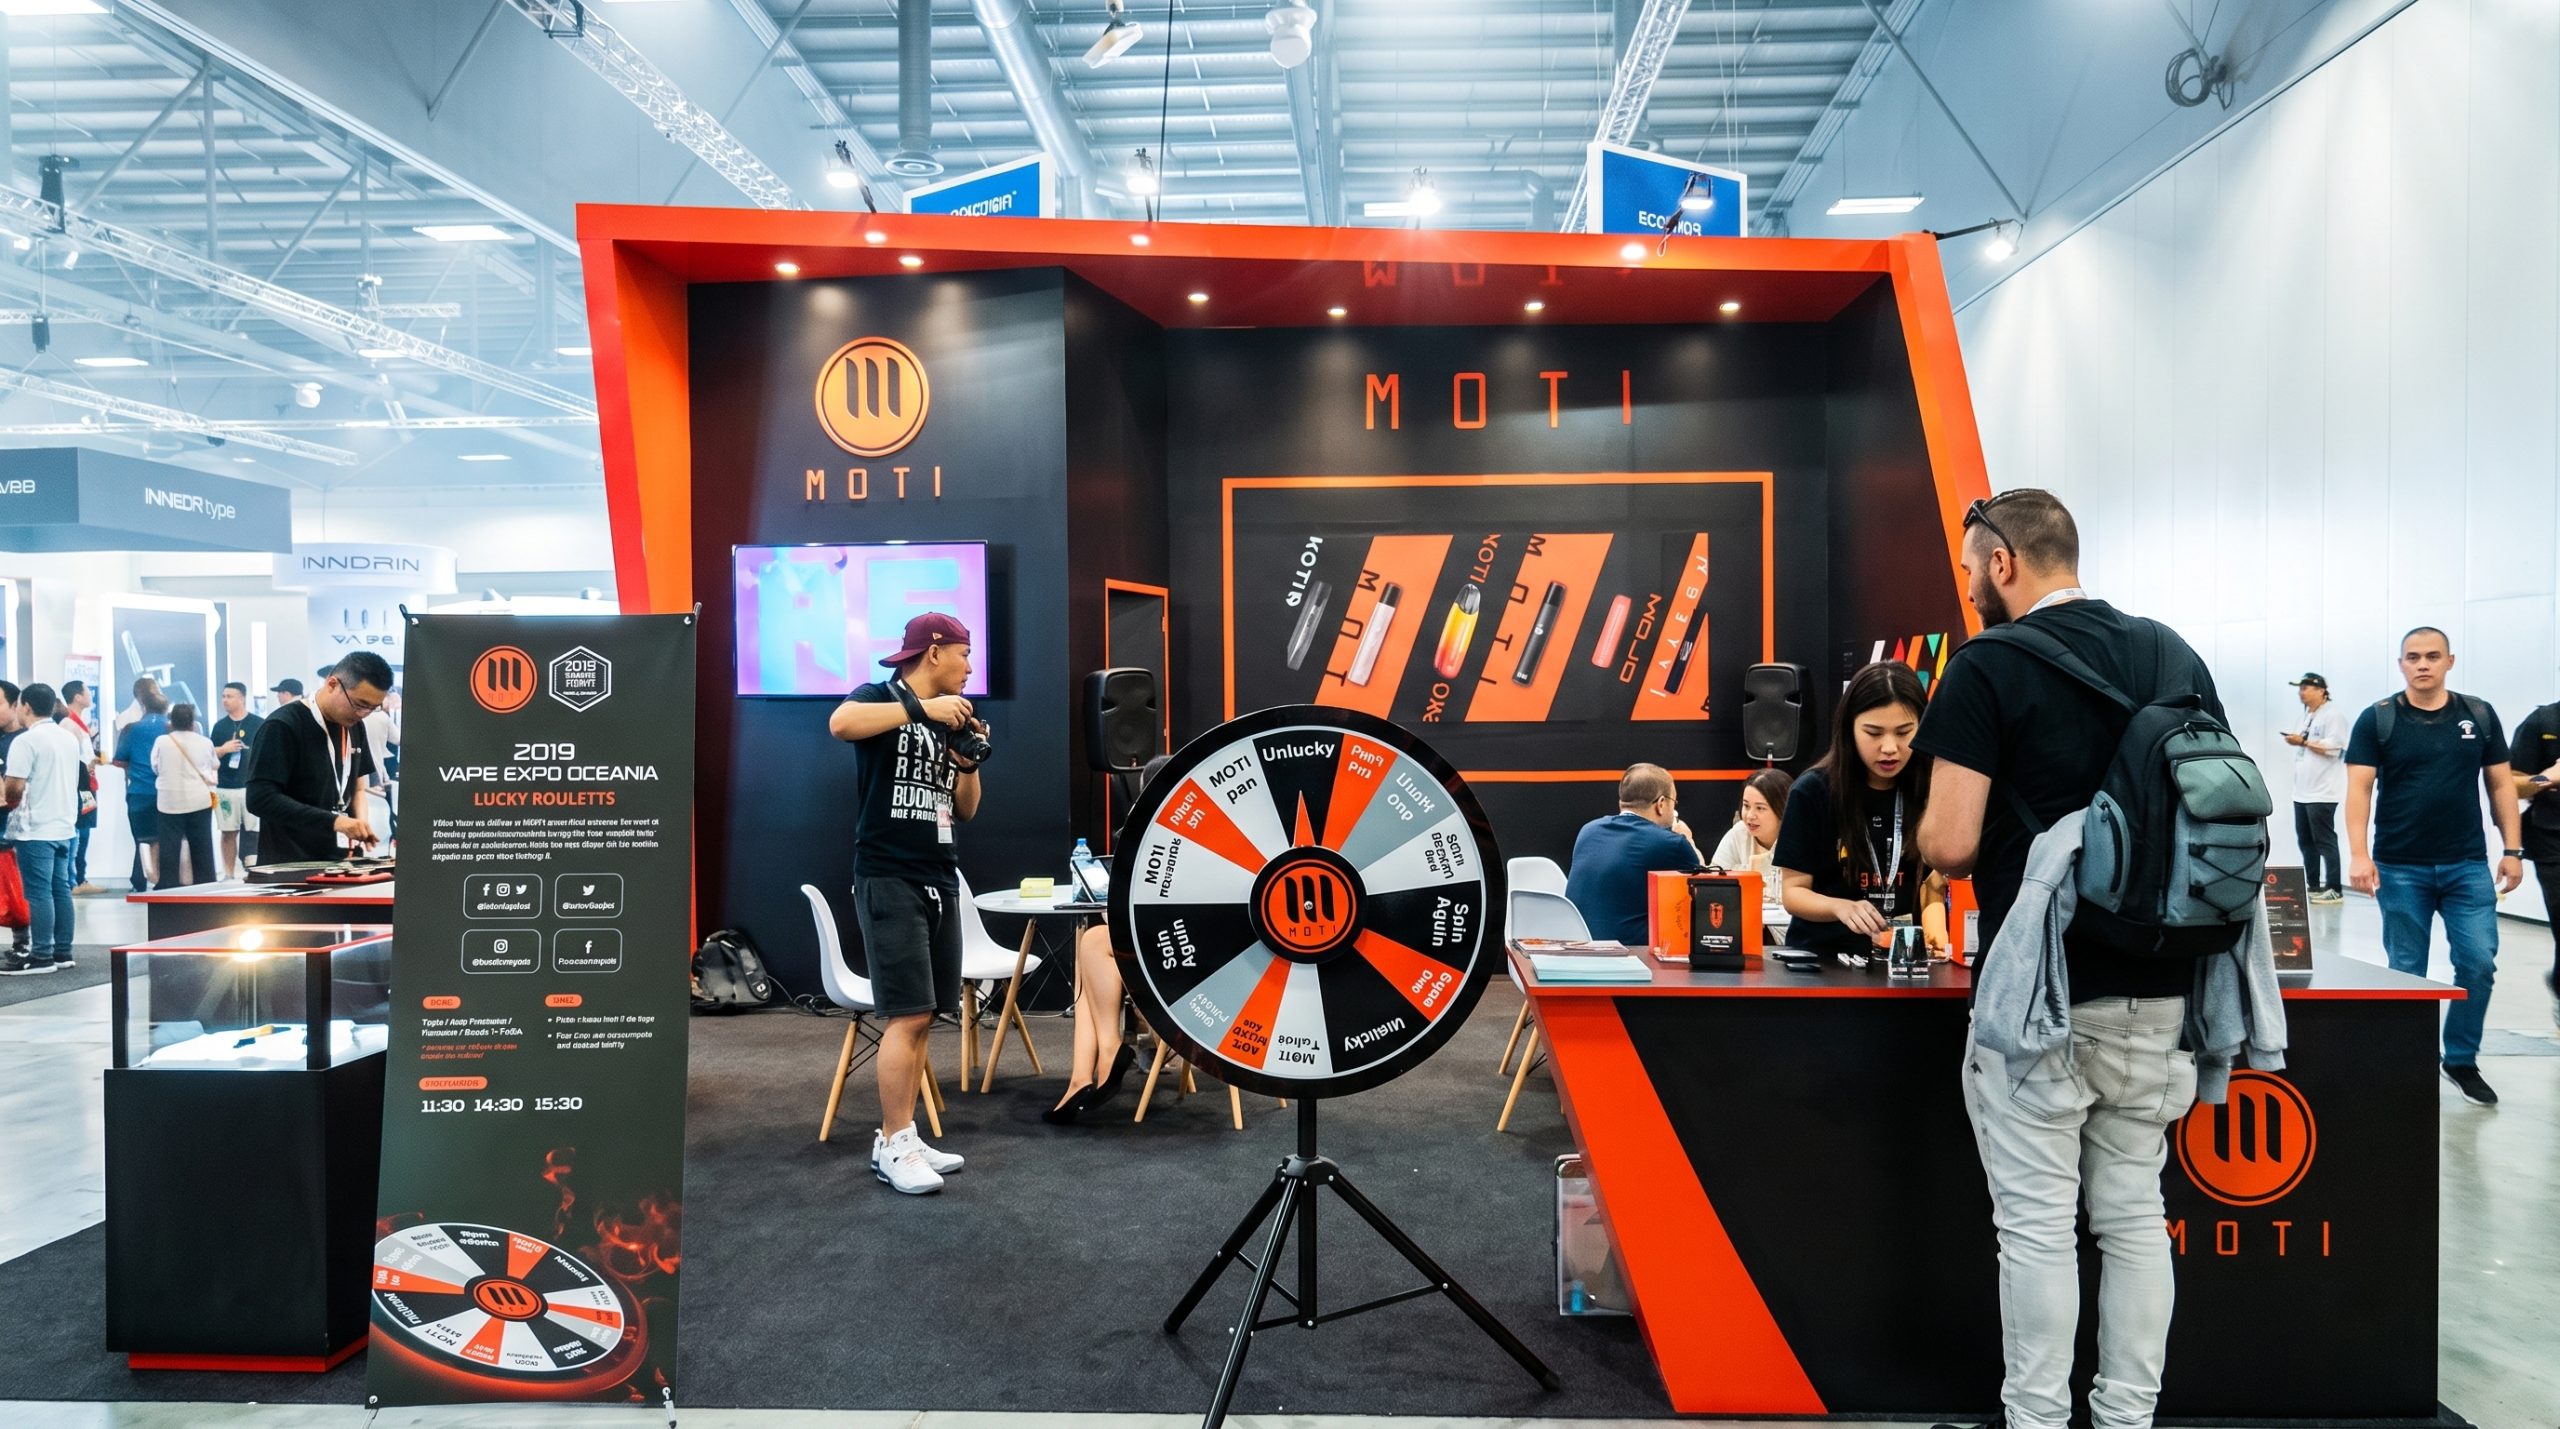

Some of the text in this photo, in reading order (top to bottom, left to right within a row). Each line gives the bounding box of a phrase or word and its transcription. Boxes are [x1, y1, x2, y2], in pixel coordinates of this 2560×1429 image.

[1365, 370, 1632, 430] MOTI
[806, 466, 942, 500] MOTI
[205, 499, 236, 520] type
[303, 556, 420, 571] INNDRIN
[513, 743, 575, 761] 2019
[1262, 741, 1336, 762] Unlucky
[439, 765, 659, 782] VAPE EXPO OCEANIA
[1209, 755, 1252, 788] MOTI
[474, 791, 616, 807] LUCKY ROULETTS
[1226, 777, 1258, 804] pan
[1144, 844, 1166, 884] MOTI
[1289, 926, 1336, 937] MOTI
[1432, 896, 1451, 946] Aguin
[1451, 903, 1469, 943] Spin
[1173, 918, 1197, 968] Aguin
[421, 1097, 583, 1113] 11:30 14:30 15:30
[2165, 1219, 2330, 1256] MOTI
